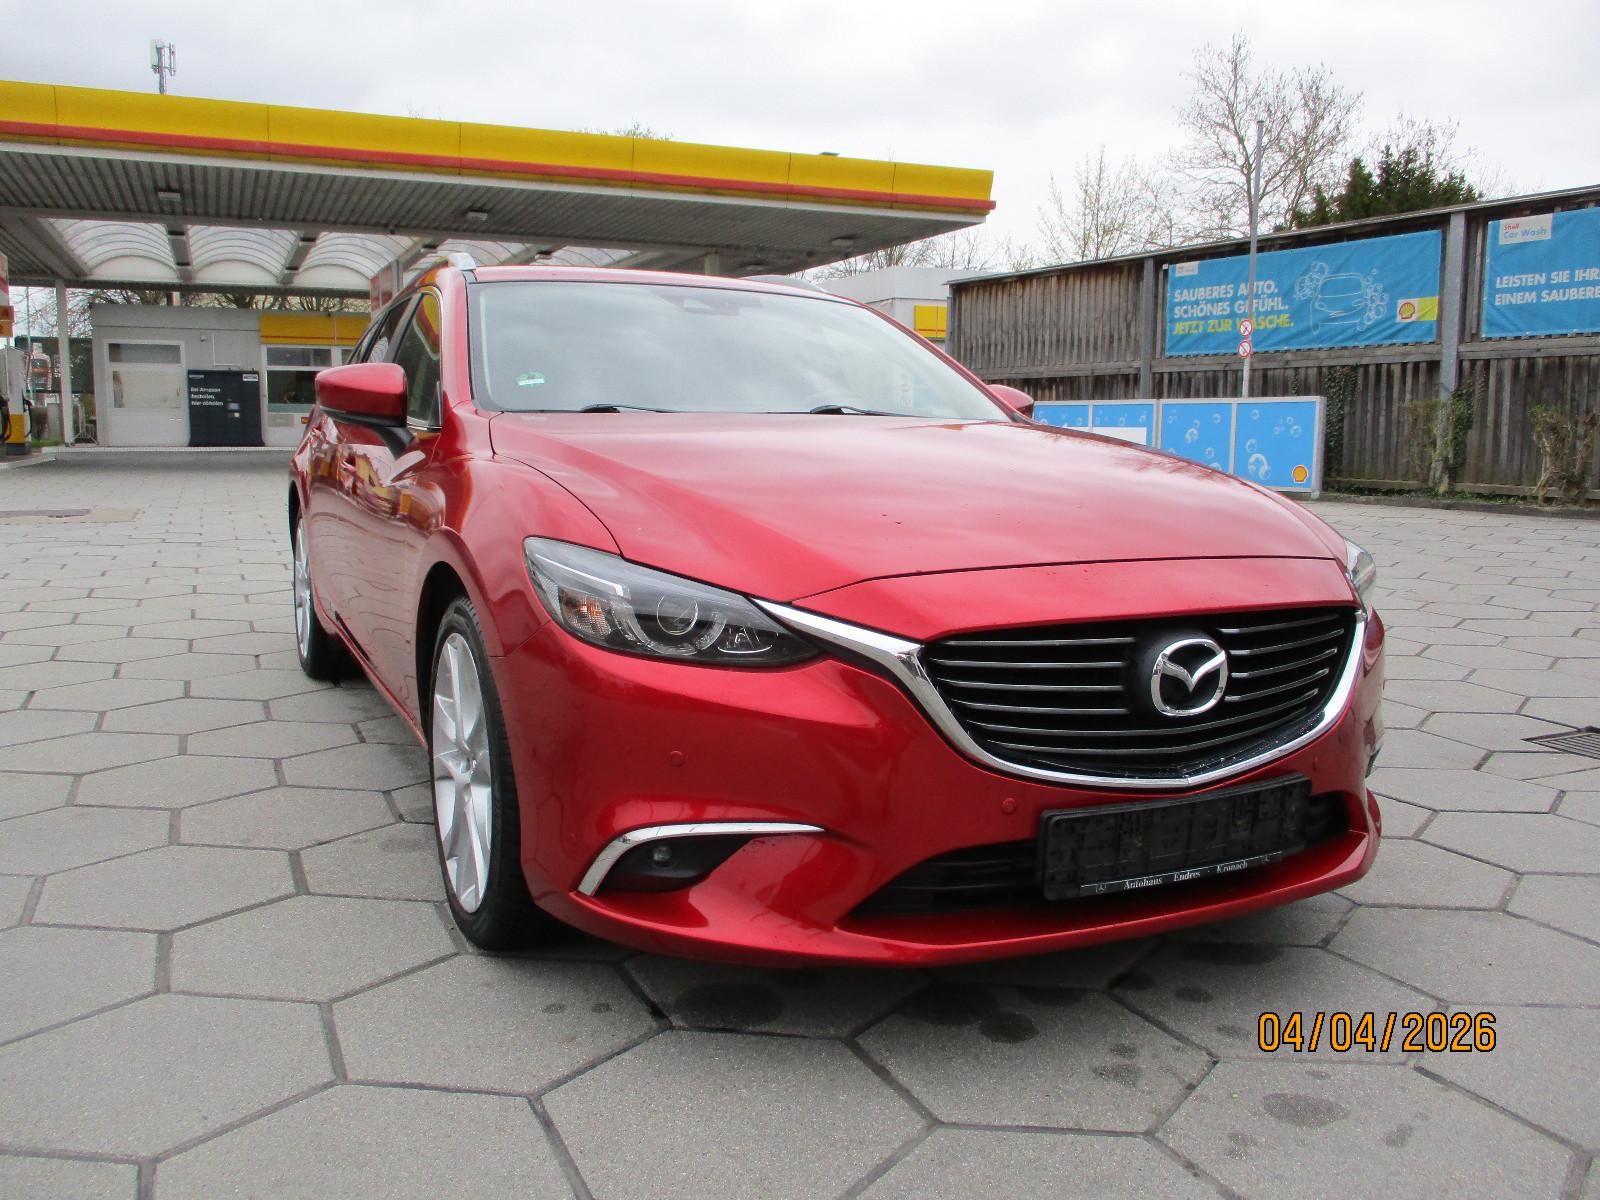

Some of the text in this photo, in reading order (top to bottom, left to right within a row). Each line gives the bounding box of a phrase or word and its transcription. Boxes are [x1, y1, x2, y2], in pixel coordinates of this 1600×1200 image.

[1503, 226, 1547, 239] Car Wash
[1495, 272, 1547, 289] LEISTEN
[1550, 270, 1571, 284] SIE
[1174, 283, 1235, 302] SAUBERES
[1494, 290, 1538, 306] EINEM
[1173, 300, 1231, 319] SCHÖNES
[1172, 320, 1205, 335] JETZT
[1207, 318, 1233, 333] ZUR
[1123, 860, 1249, 891] Autohaus Endres Kronach
